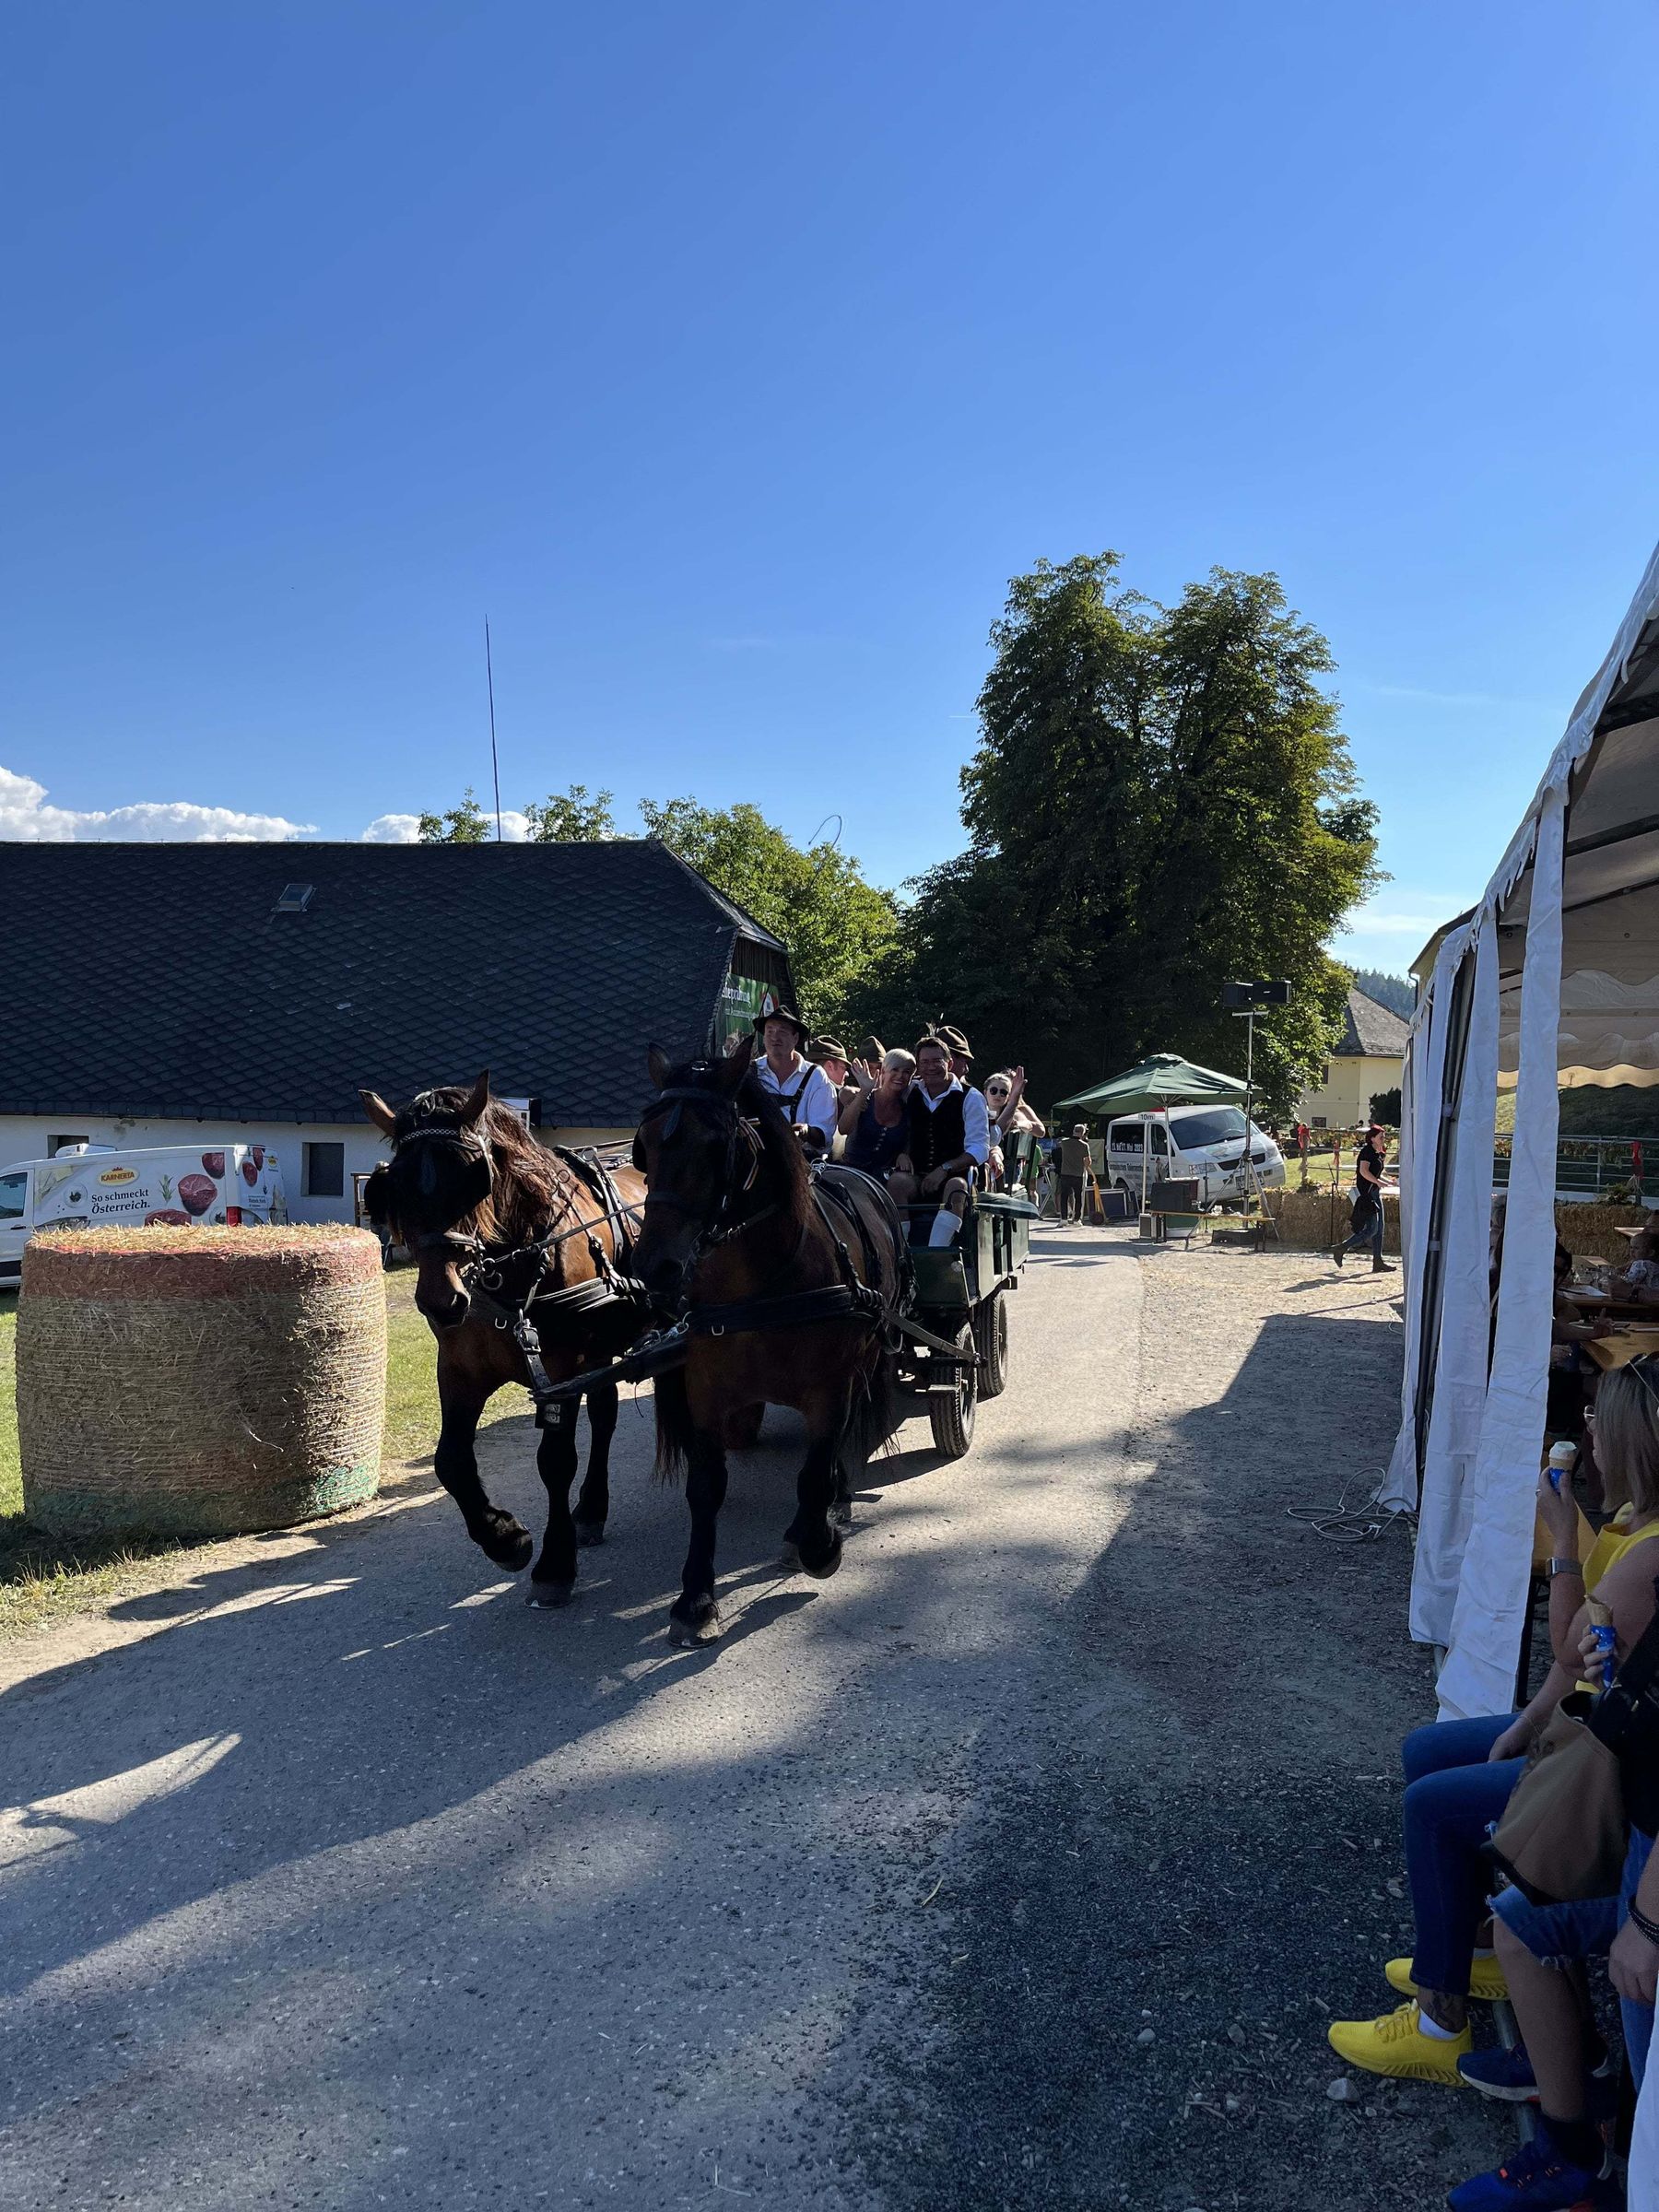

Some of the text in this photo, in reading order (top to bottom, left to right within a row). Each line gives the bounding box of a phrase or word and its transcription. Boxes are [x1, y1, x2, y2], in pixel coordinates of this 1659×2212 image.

[91, 1188, 149, 1203] So schmeckt
[91, 1199, 151, 1215] Österreich.
